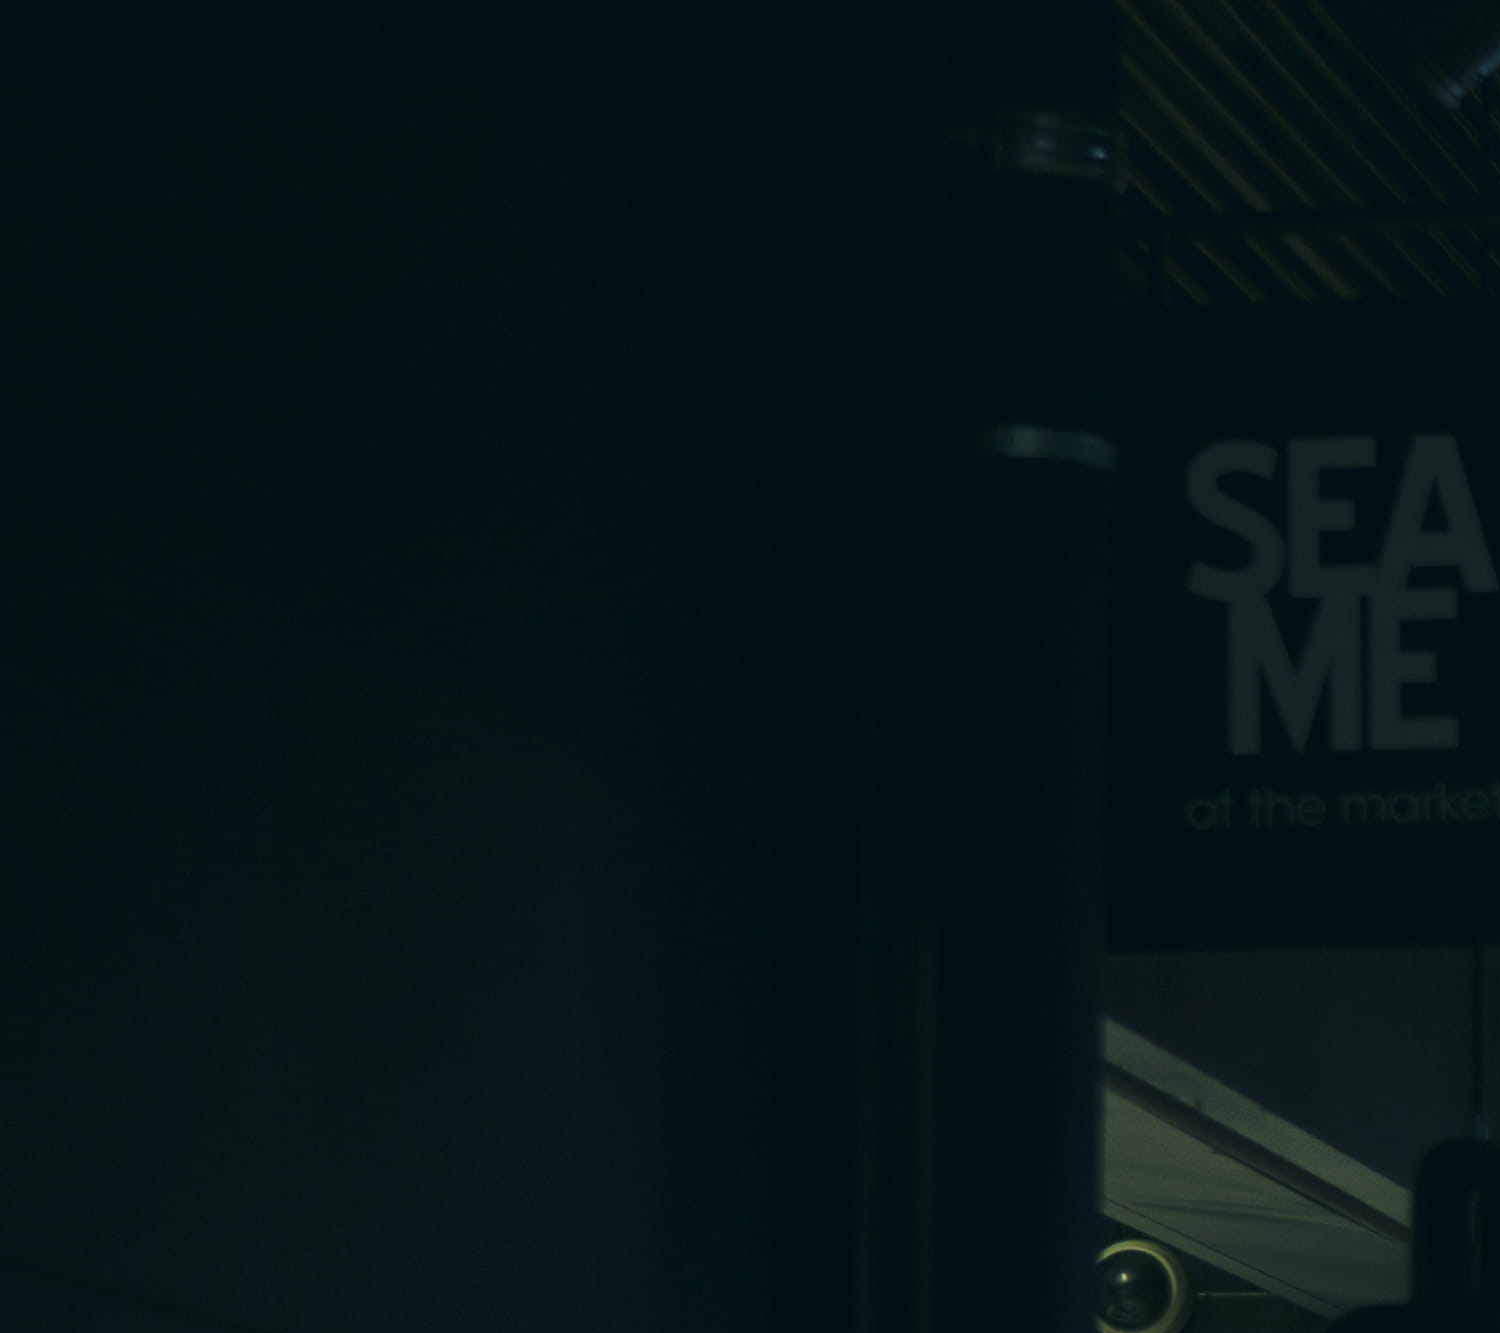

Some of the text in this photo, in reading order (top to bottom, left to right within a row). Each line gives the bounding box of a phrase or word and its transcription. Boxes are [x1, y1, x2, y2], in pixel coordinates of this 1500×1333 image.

[1184, 432, 1500, 603] SEA
[1226, 588, 1460, 756] ME
[1184, 790, 1235, 830] at
[1249, 788, 1327, 827] the
